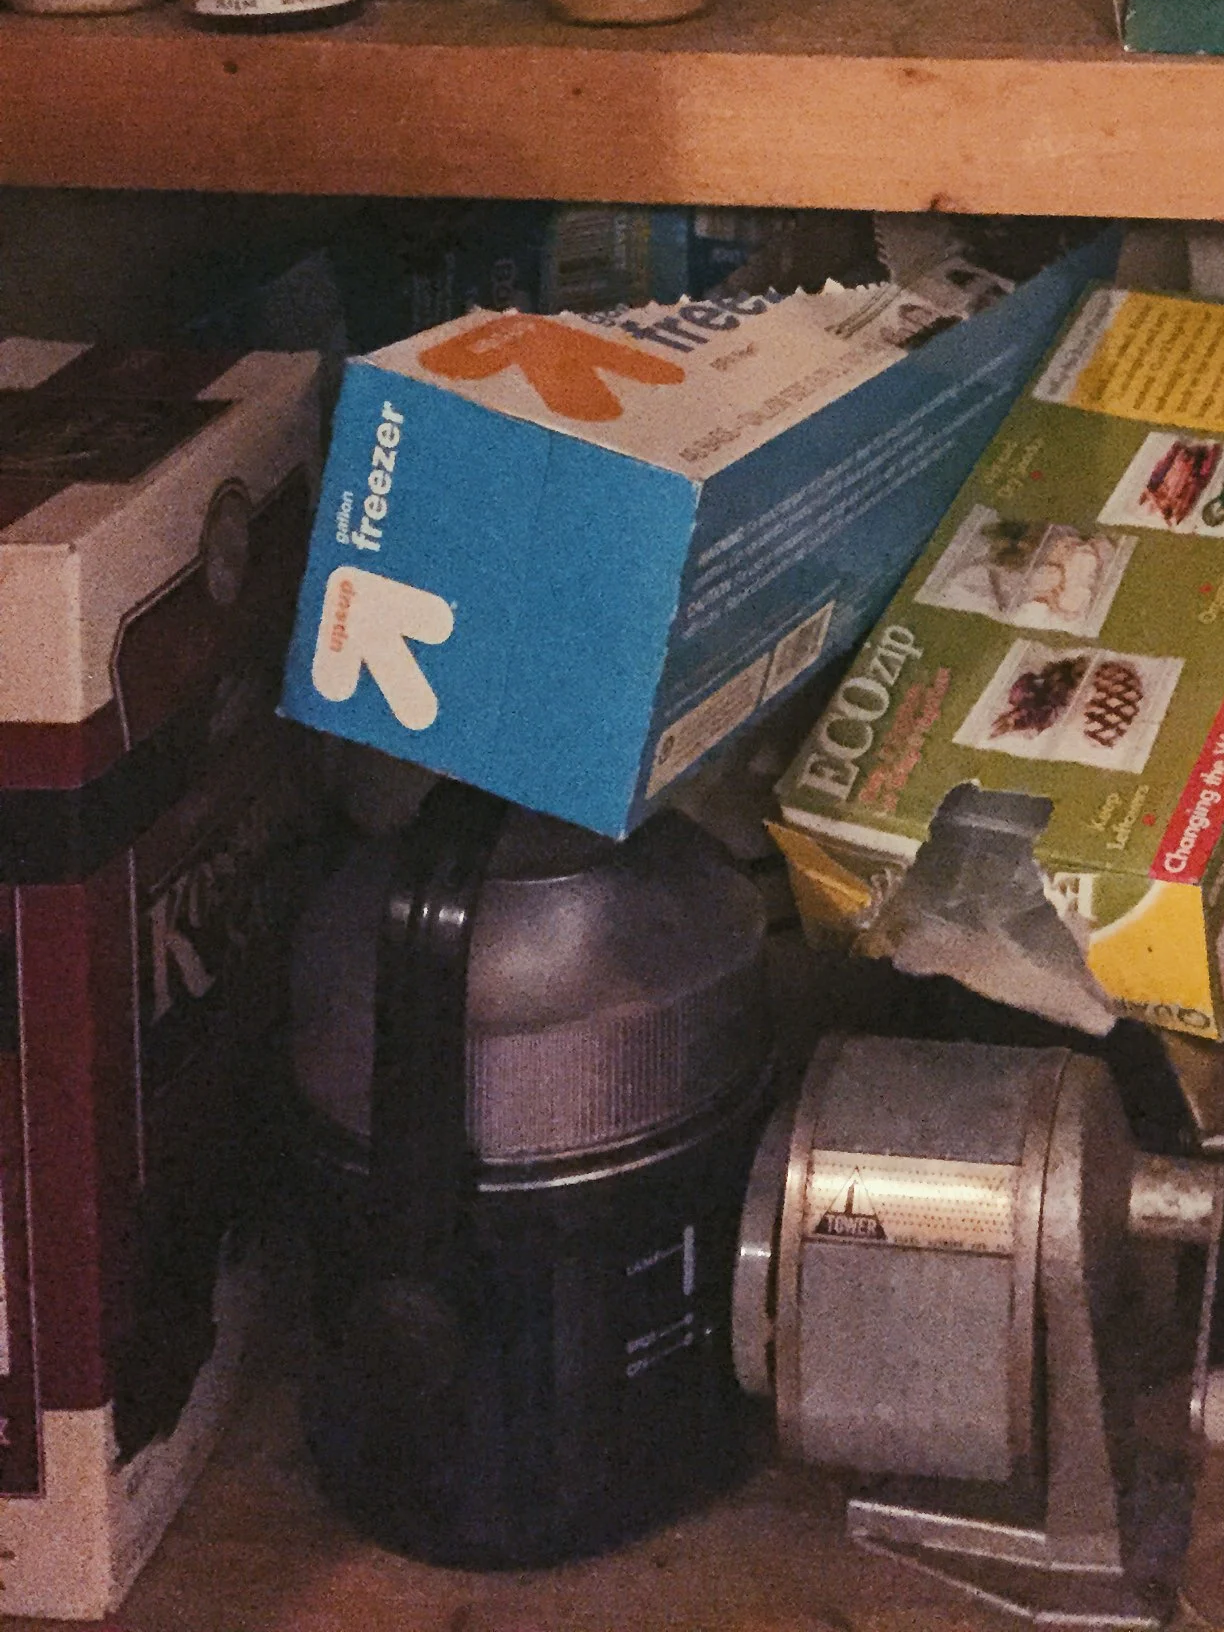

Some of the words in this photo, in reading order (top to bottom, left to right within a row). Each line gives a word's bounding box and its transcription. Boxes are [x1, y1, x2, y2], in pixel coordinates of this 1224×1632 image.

[620, 290, 786, 353] free
[351, 400, 404, 553] freezer
[335, 490, 354, 545] gallon
[798, 624, 925, 801] ECOzip
[1163, 788, 1222, 874] Changing
[825, 1214, 877, 1236] TOWER
